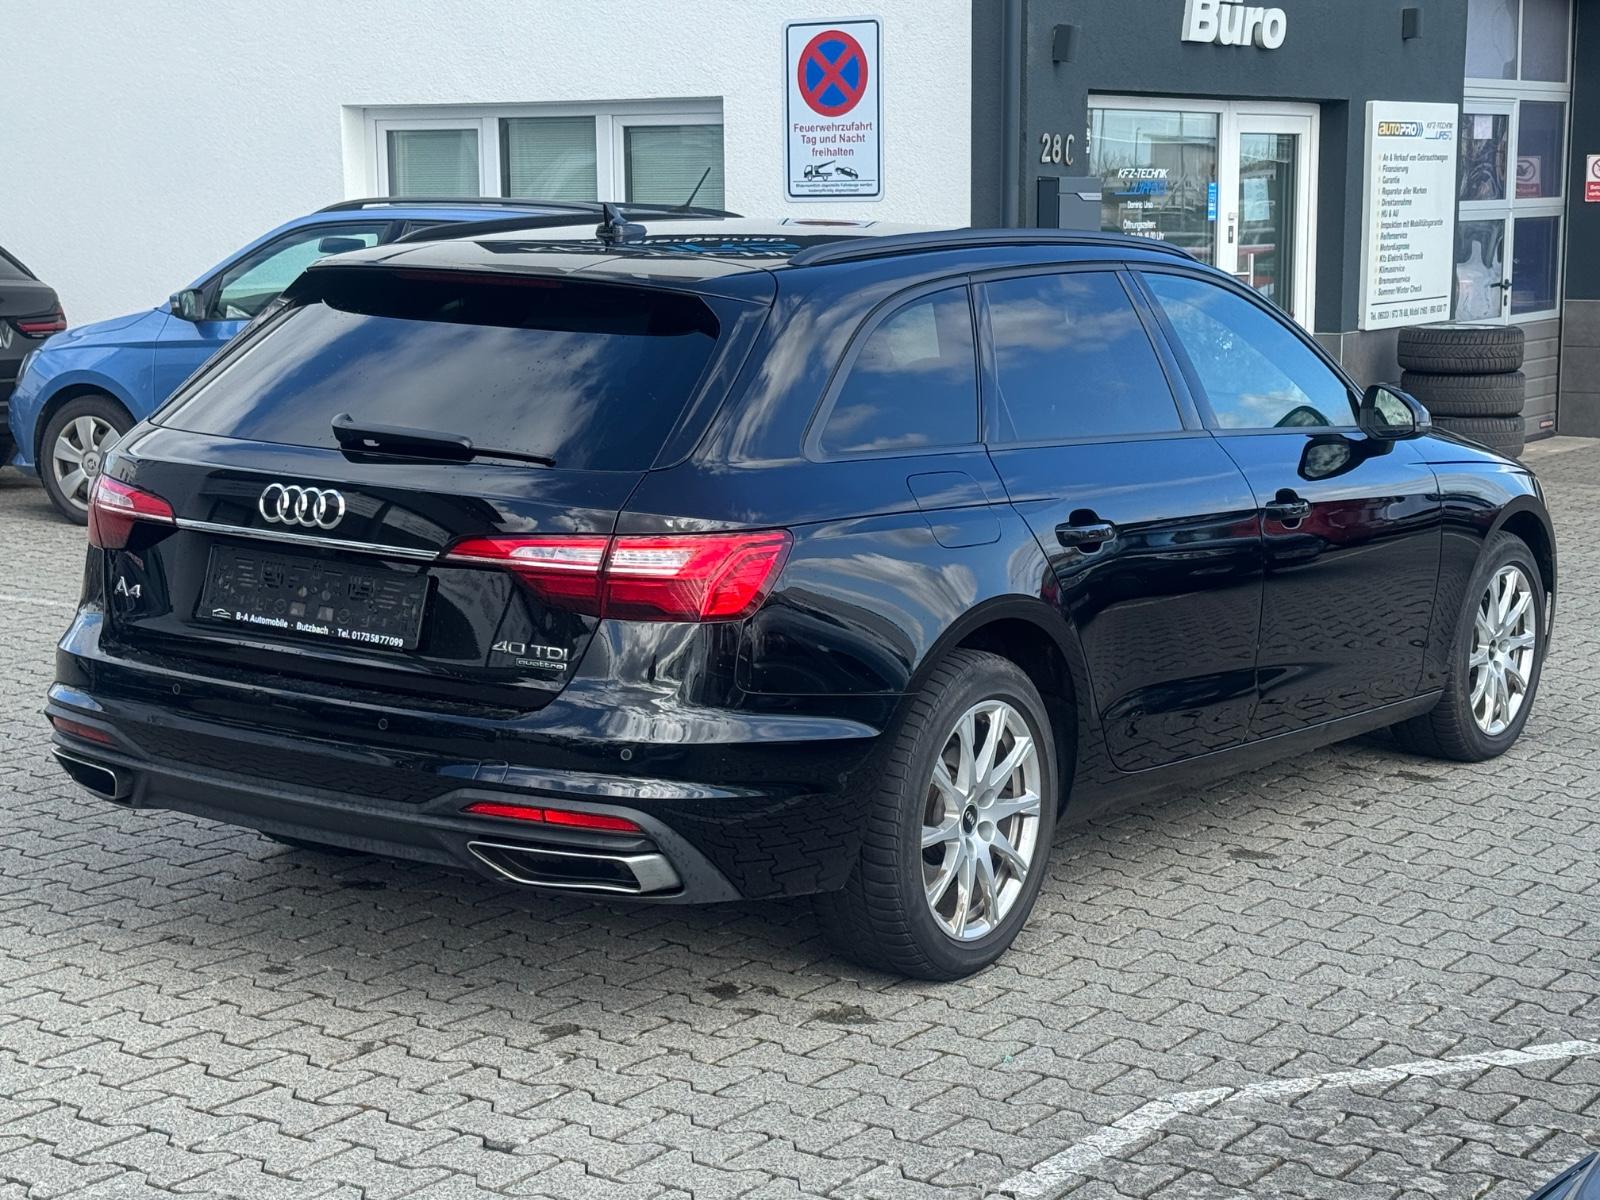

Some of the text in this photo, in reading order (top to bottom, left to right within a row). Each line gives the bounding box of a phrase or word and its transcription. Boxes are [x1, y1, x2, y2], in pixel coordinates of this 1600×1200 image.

[1181, 0, 1287, 49] Büro
[793, 122, 873, 133] Feuerwehrzufahrt
[801, 133, 866, 146] Tag und Nacht
[812, 147, 854, 157] freihalten
[1041, 132, 1062, 164] 28
[1117, 167, 1170, 179] KFZ-TECHNIK
[1382, 165, 1409, 174] Finanzierung
[1382, 176, 1400, 184] Garantie
[1379, 265, 1406, 273] Klimaservice
[114, 575, 141, 598] A4
[235, 611, 404, 648] B-A Automobile Butzbach Tel. 01735877099
[492, 640, 568, 661] 40 TDI
[517, 659, 565, 670] quattro
